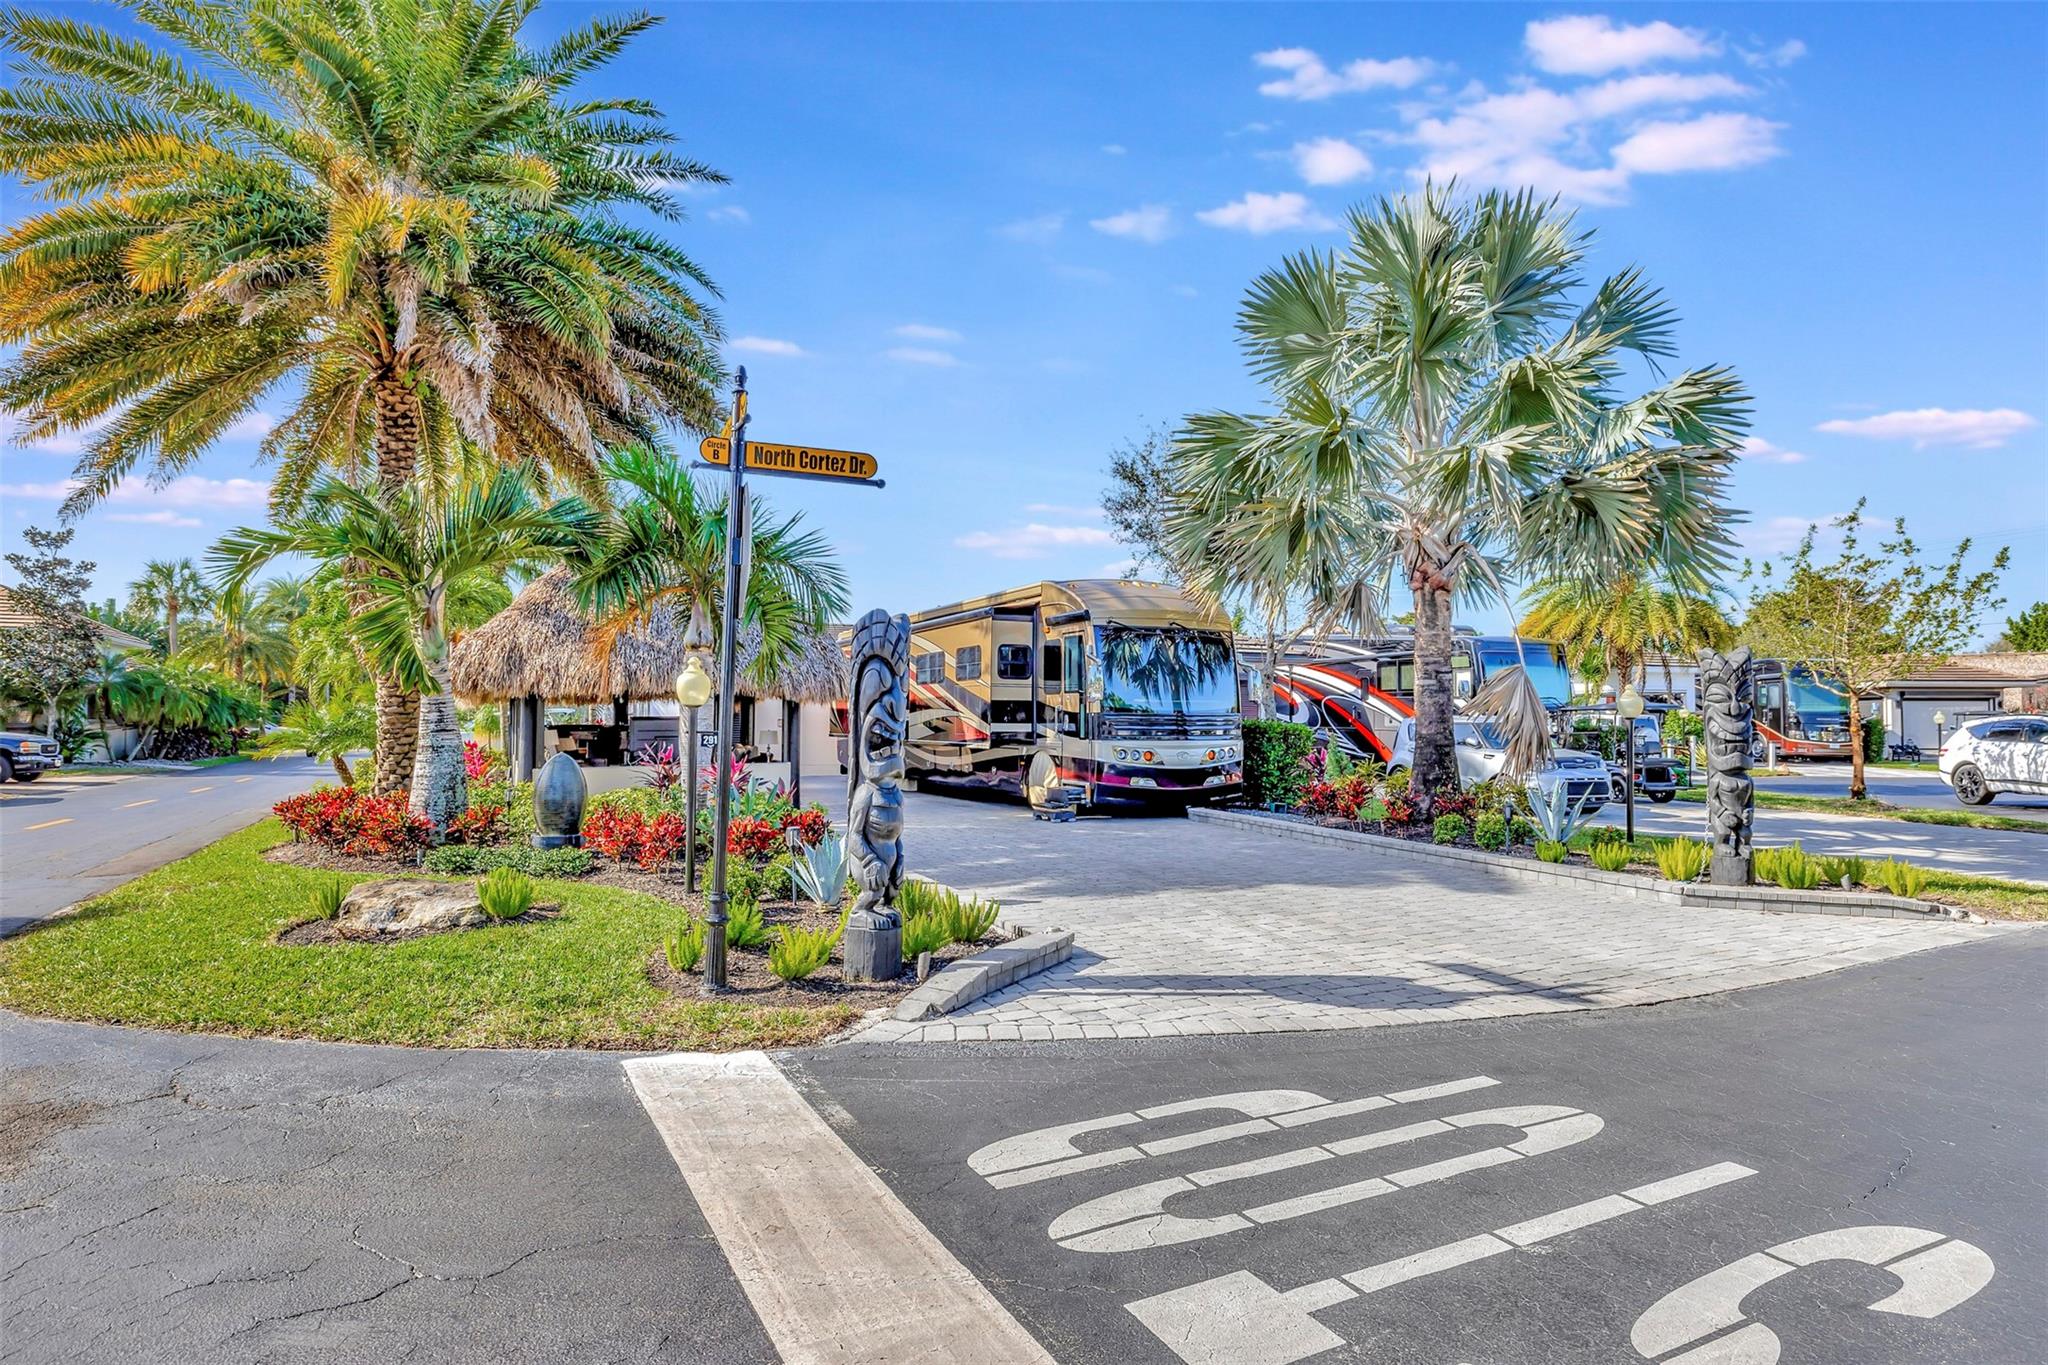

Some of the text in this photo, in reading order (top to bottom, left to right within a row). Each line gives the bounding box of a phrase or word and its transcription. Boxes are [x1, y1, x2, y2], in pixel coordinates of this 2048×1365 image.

[707, 440, 726, 450] Circle
[713, 449, 720, 460] B
[754, 445, 867, 475] North Cortez Dr.
[703, 735, 717, 745] 291
